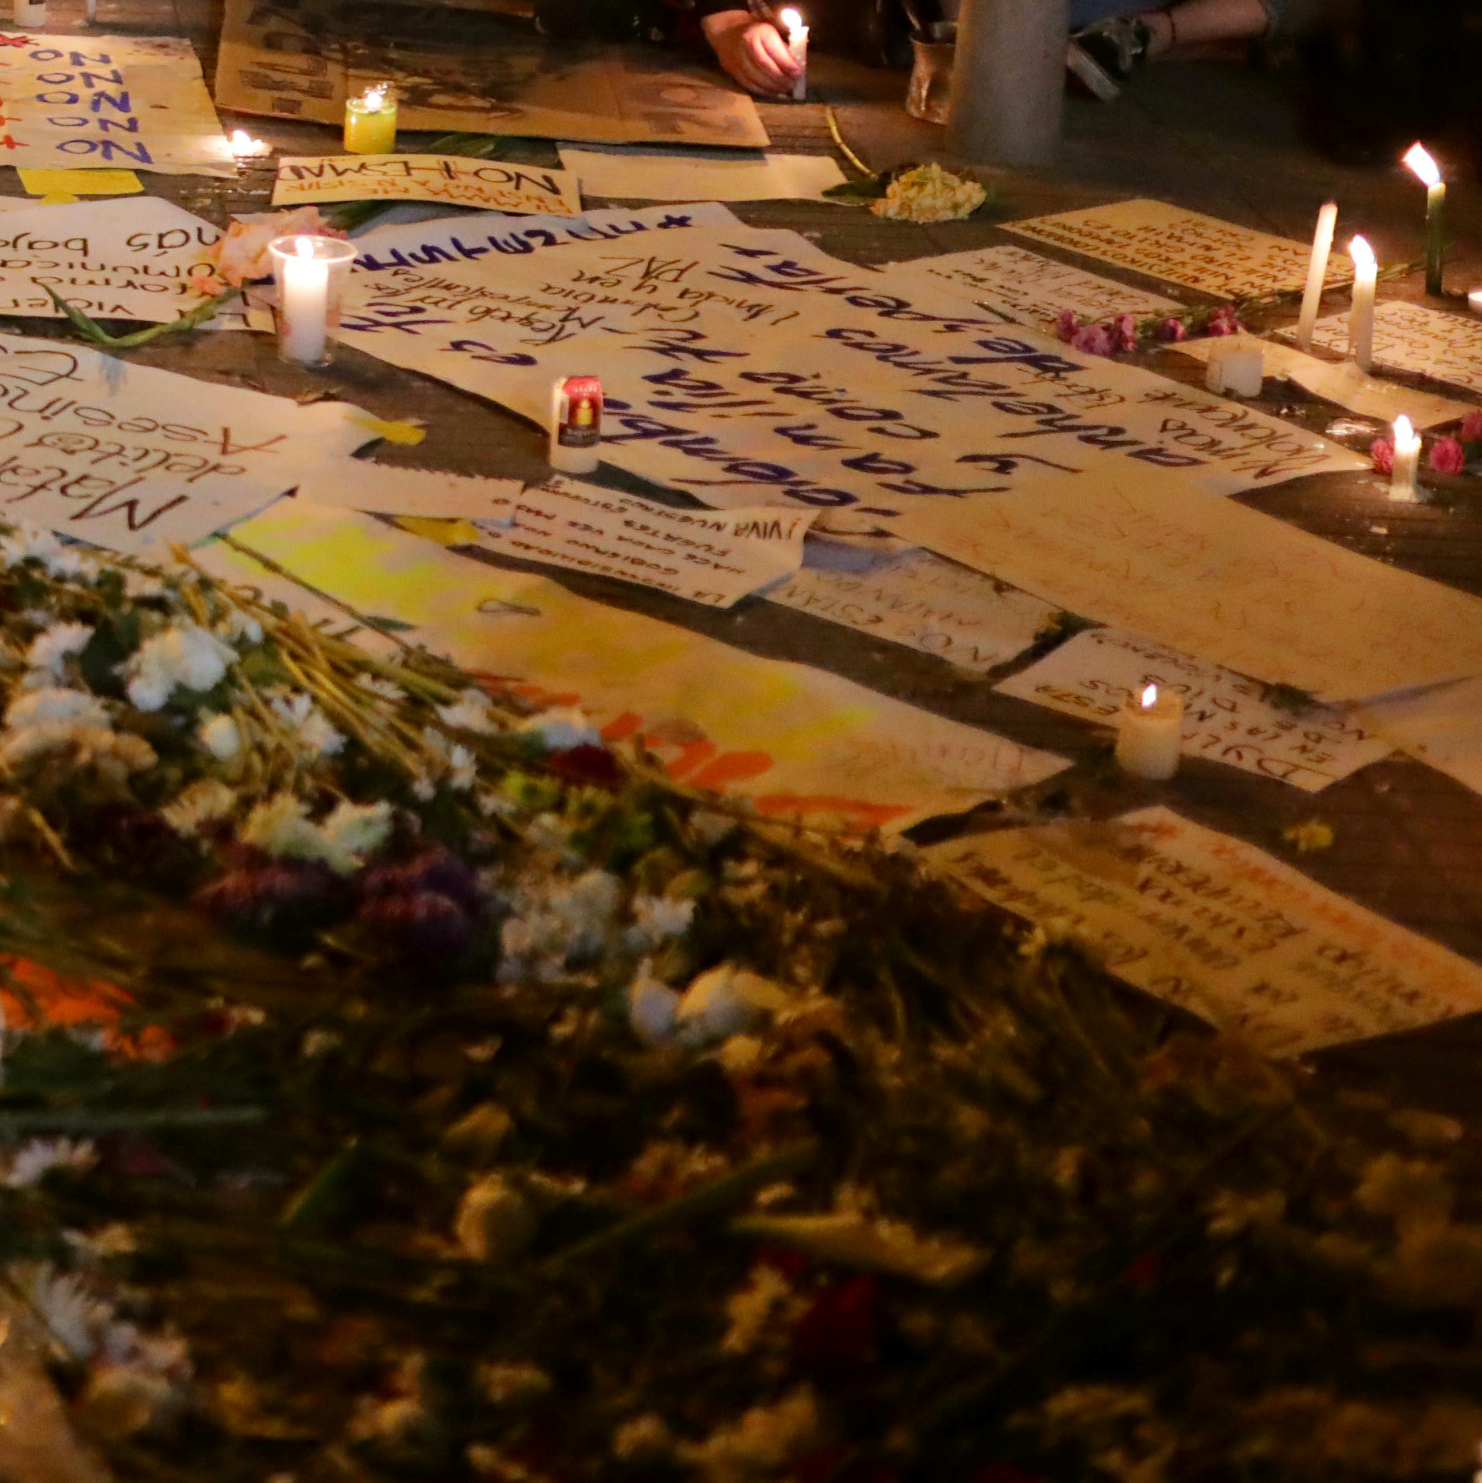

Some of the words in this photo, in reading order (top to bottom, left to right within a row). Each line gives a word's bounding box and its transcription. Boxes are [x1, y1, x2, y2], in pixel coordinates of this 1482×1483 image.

[28, 49, 112, 67] No
[35, 69, 123, 89] No
[35, 91, 131, 114] No
[45, 116, 139, 134] No
[54, 139, 154, 165] No
[277, 160, 412, 180] ESMAD
[572, 270, 623, 288] en
[597, 255, 700, 285] PAZ
[734, 370, 942, 441] como
[810, 327, 1206, 469] anhelamos
[646, 367, 1011, 499] familia
